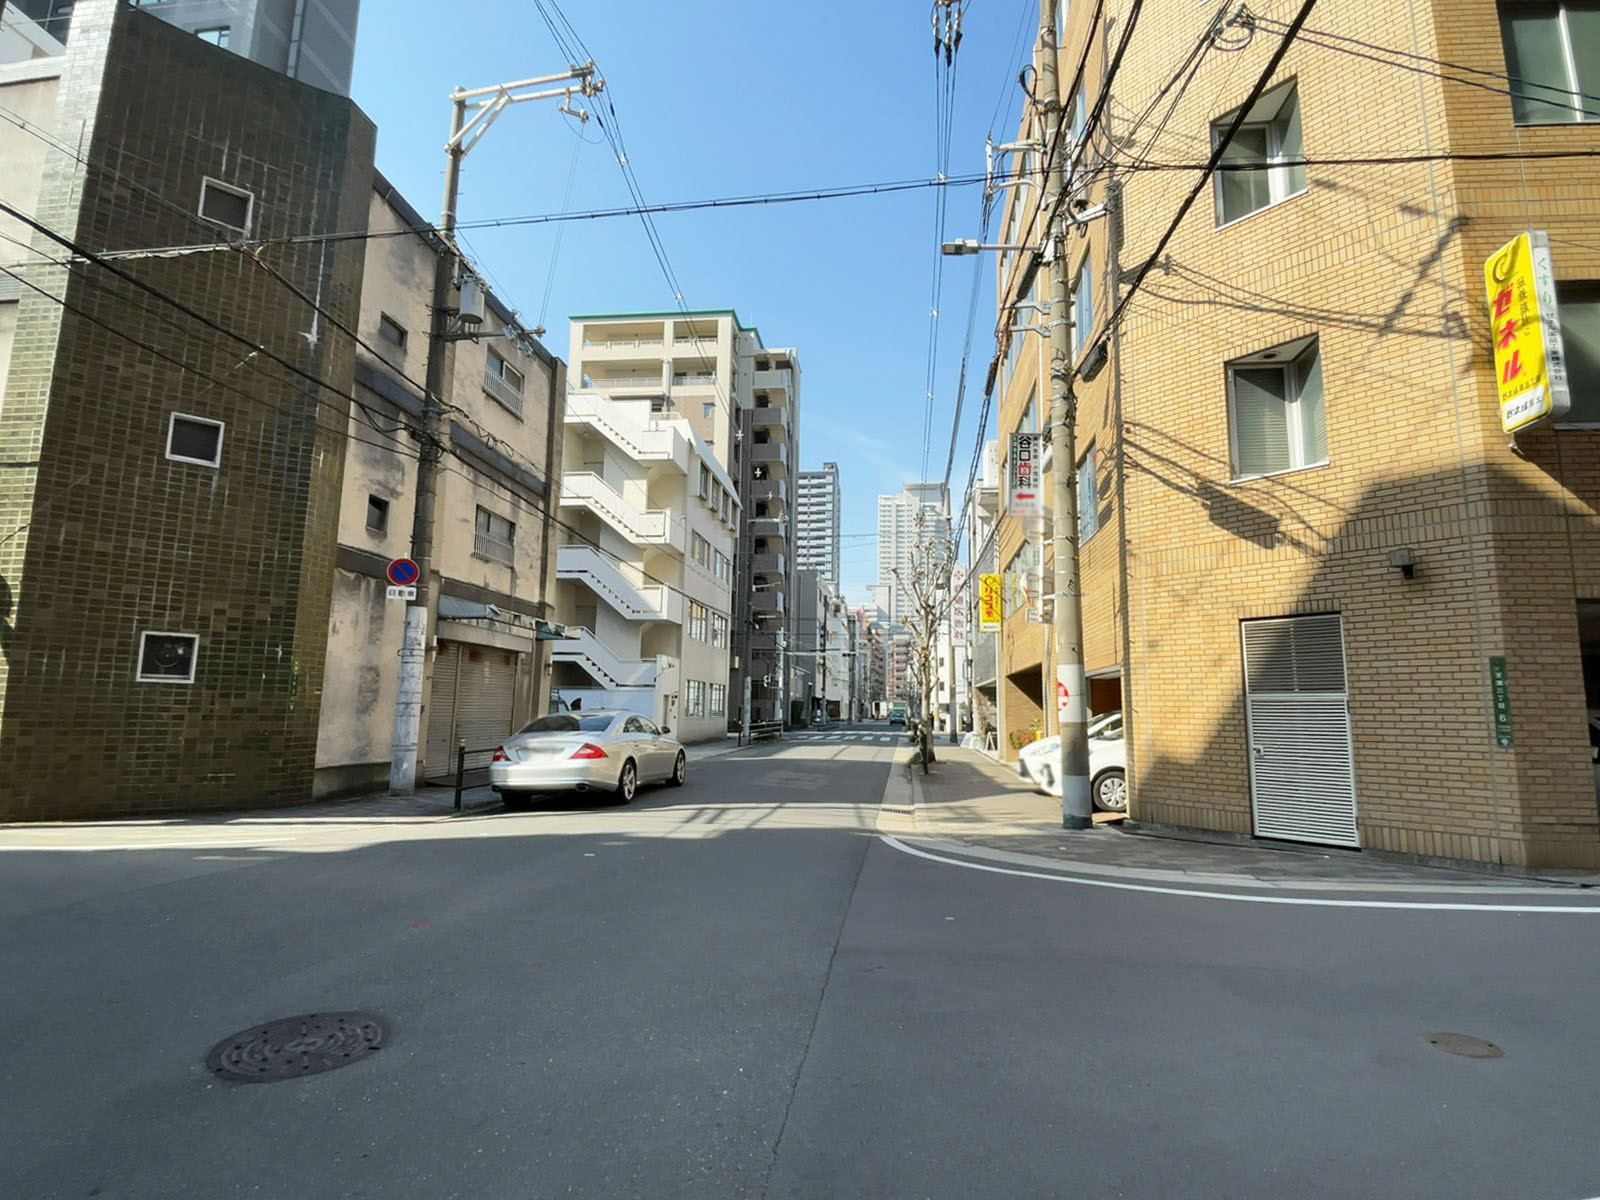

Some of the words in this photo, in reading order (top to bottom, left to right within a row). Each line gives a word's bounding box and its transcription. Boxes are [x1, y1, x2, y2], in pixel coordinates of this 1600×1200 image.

[1493, 282, 1522, 384] ゼネル
[1018, 435, 1032, 489] 谷口歯科
